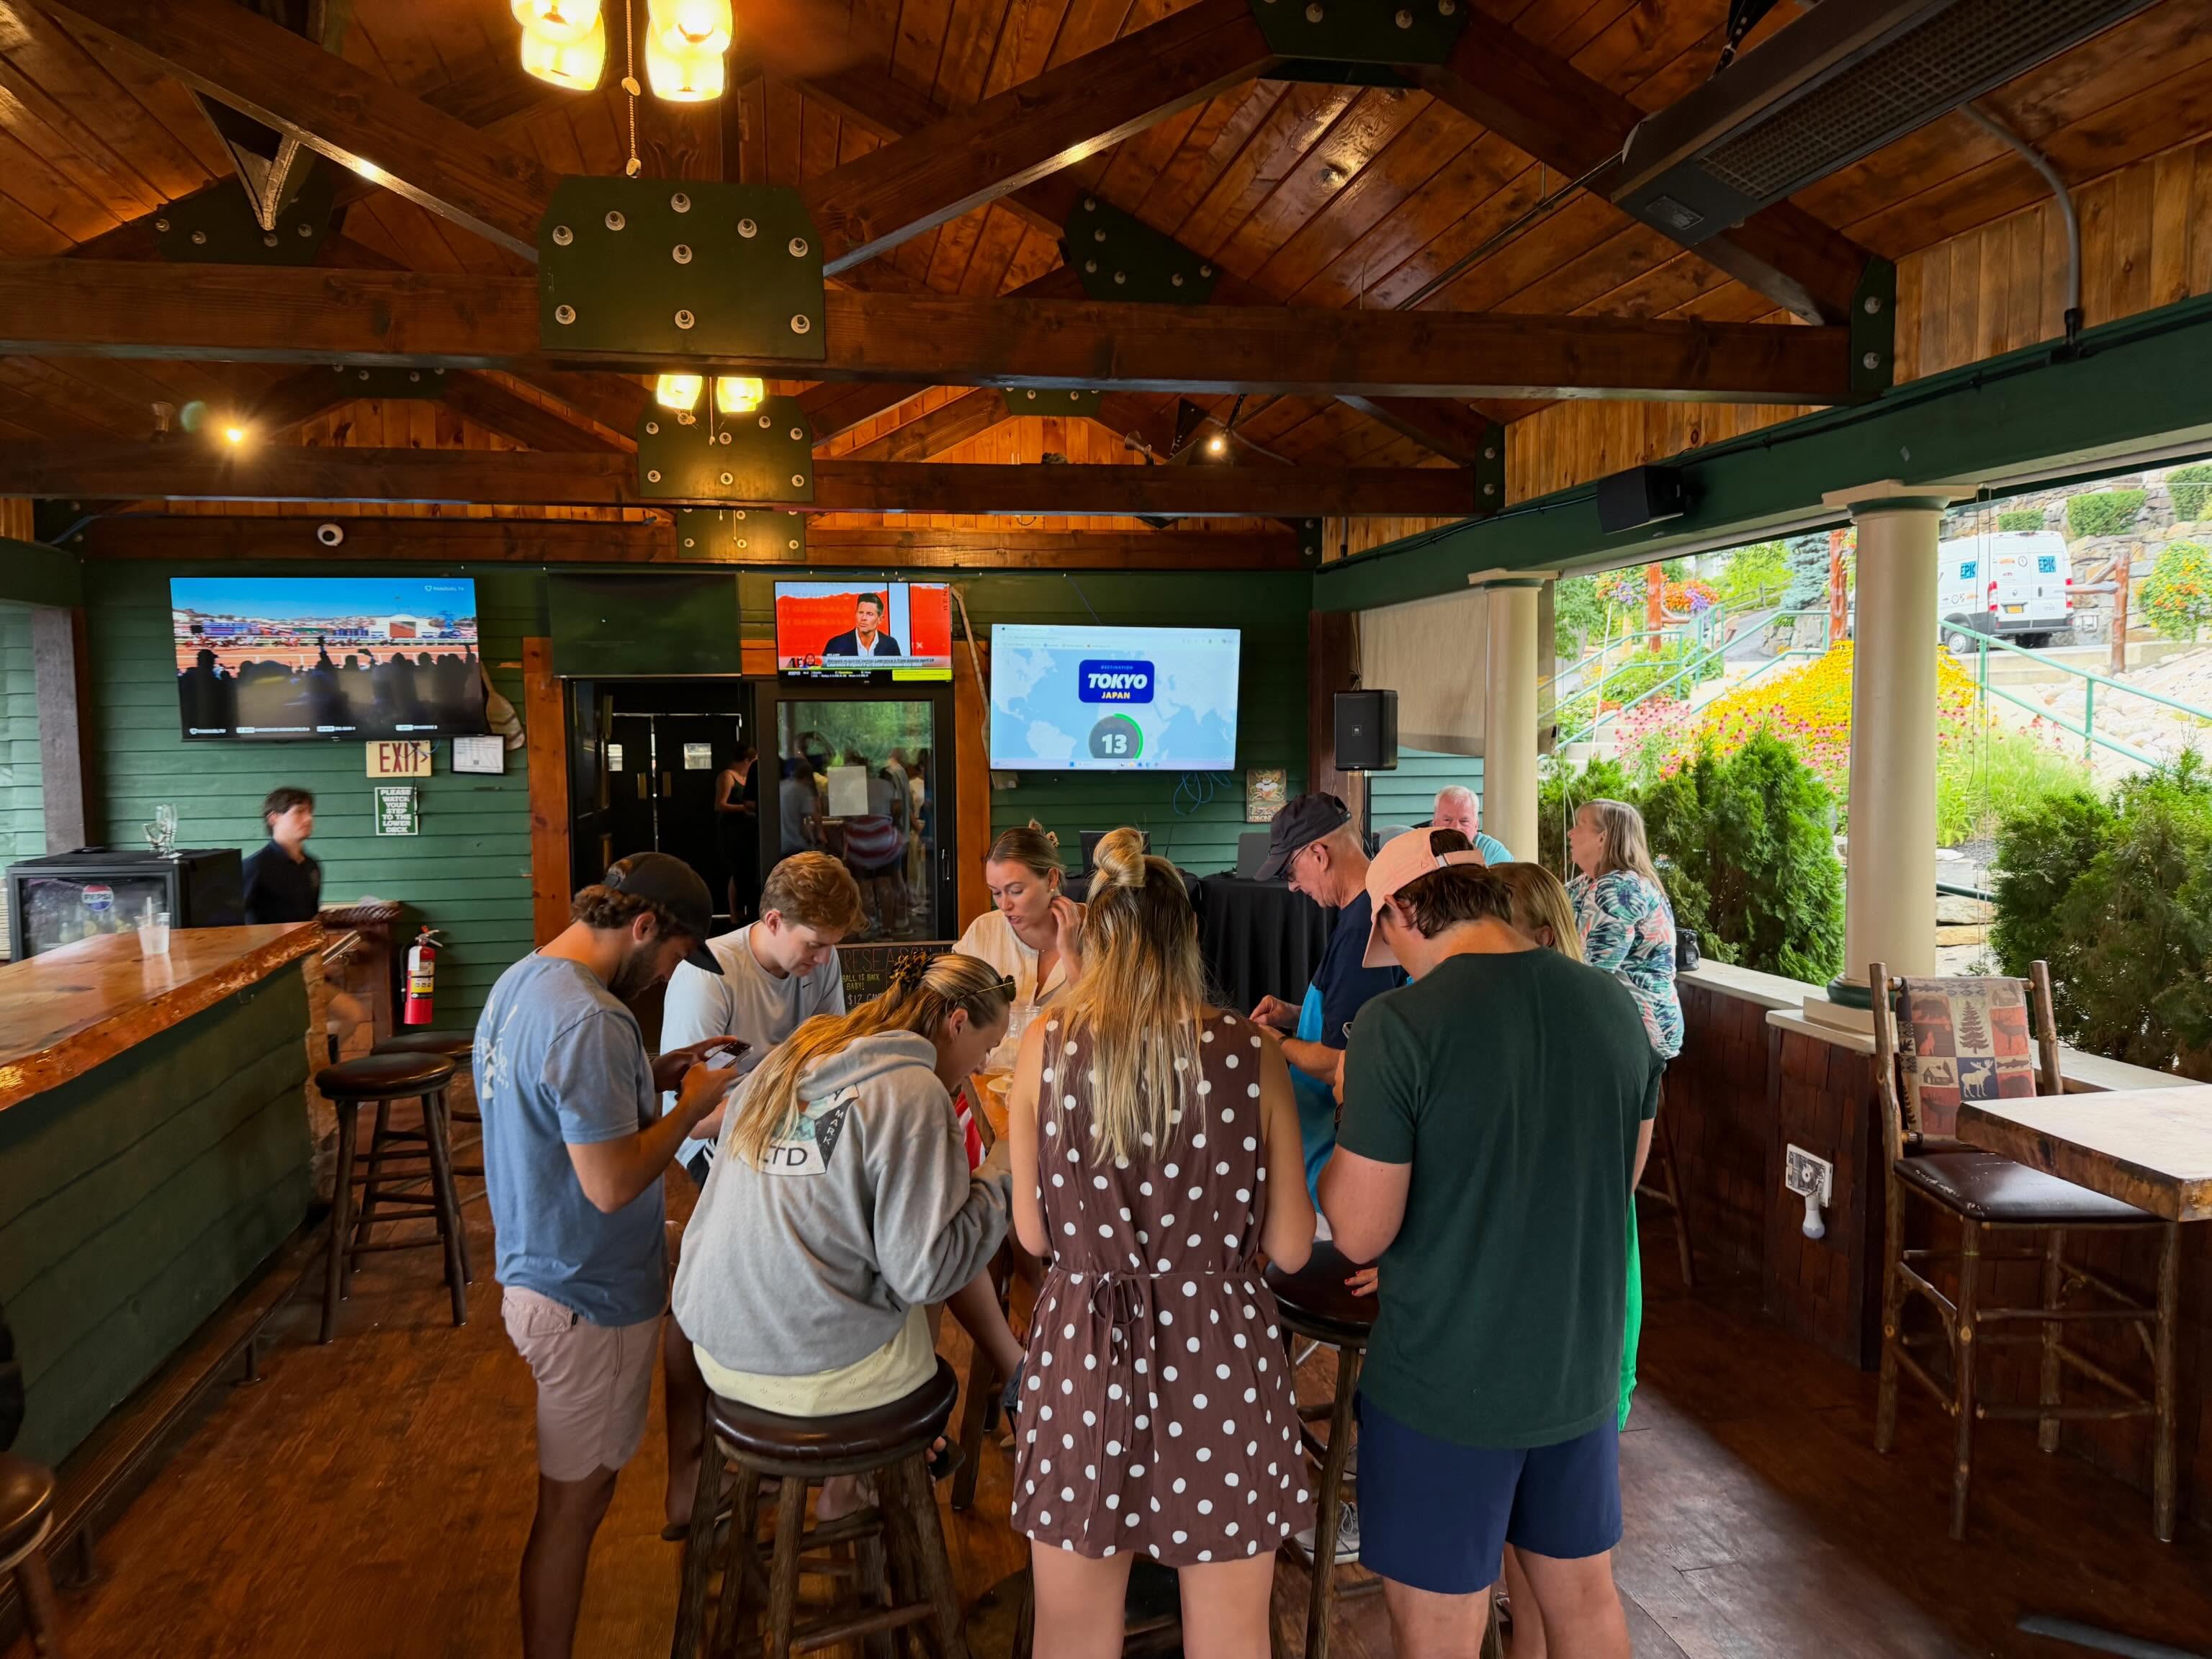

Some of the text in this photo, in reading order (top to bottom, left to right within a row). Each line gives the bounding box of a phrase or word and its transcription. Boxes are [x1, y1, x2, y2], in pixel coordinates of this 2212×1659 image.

[1960, 563, 1977, 577] EPIC
[2038, 558, 2056, 570] EPIC
[1088, 673, 1148, 689] TOKYO
[1102, 734, 1128, 754] 13
[379, 742, 421, 773] EXIT
[822, 1110, 844, 1145] MARK
[763, 1145, 808, 1166] TD
